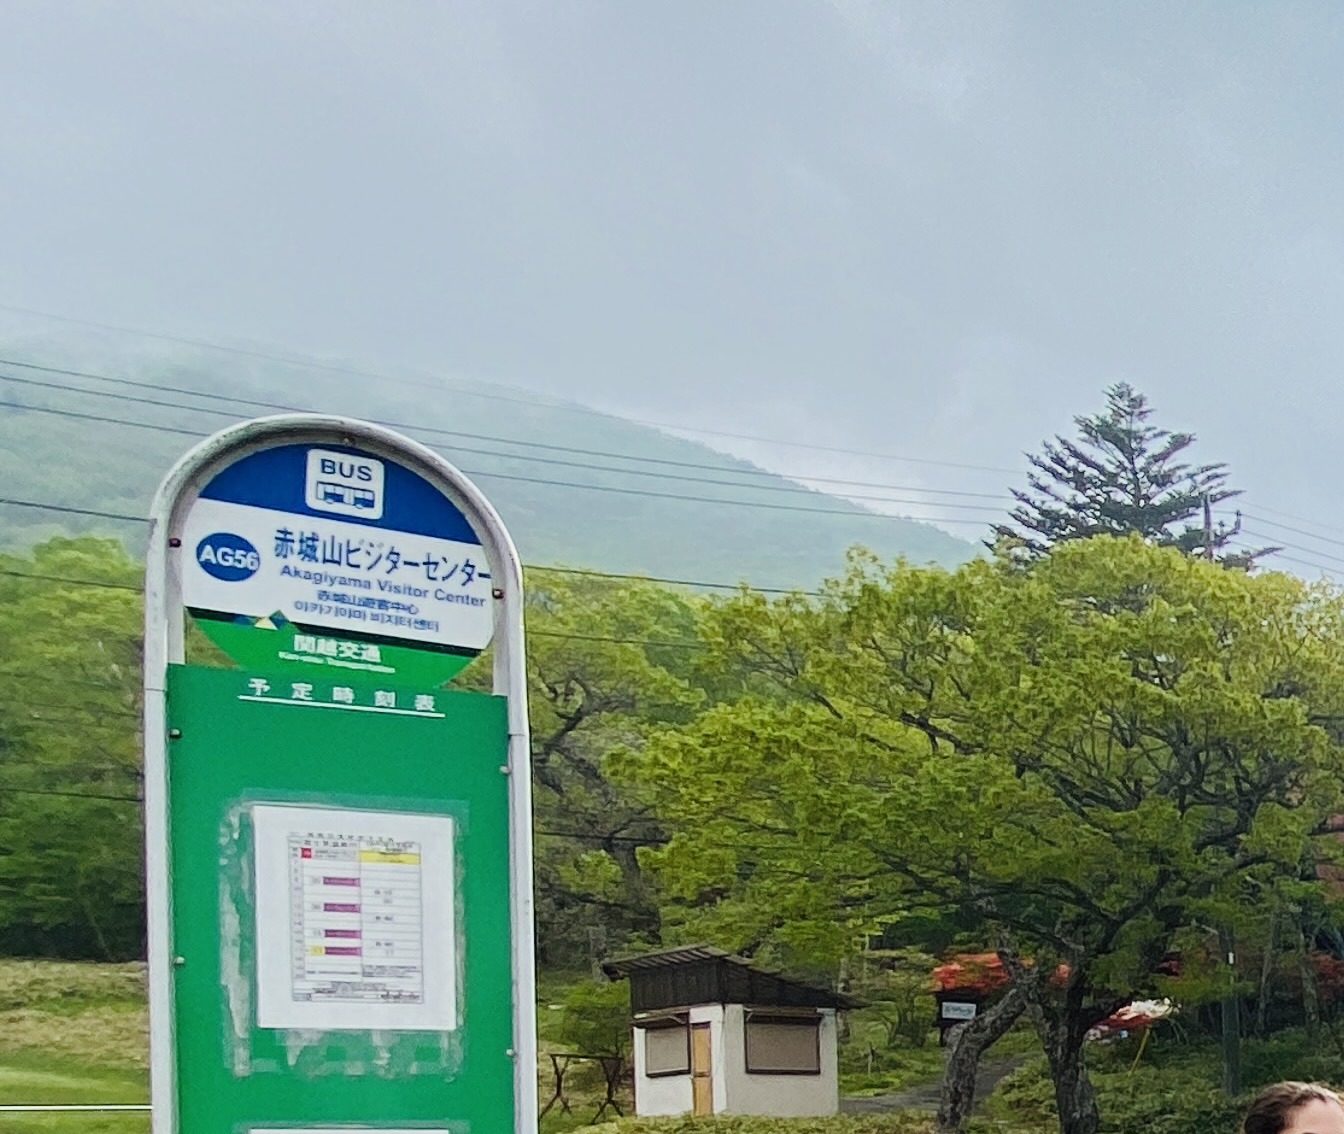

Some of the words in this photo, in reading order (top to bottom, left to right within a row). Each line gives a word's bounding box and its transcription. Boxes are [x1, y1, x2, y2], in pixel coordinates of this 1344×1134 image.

[320, 458, 372, 482] BUS
[199, 544, 260, 571] AG56
[275, 527, 491, 587] 赤城山ビジターセンター
[280, 565, 371, 590] Akagiyama
[377, 578, 429, 598] Visitor
[434, 588, 487, 608] Center
